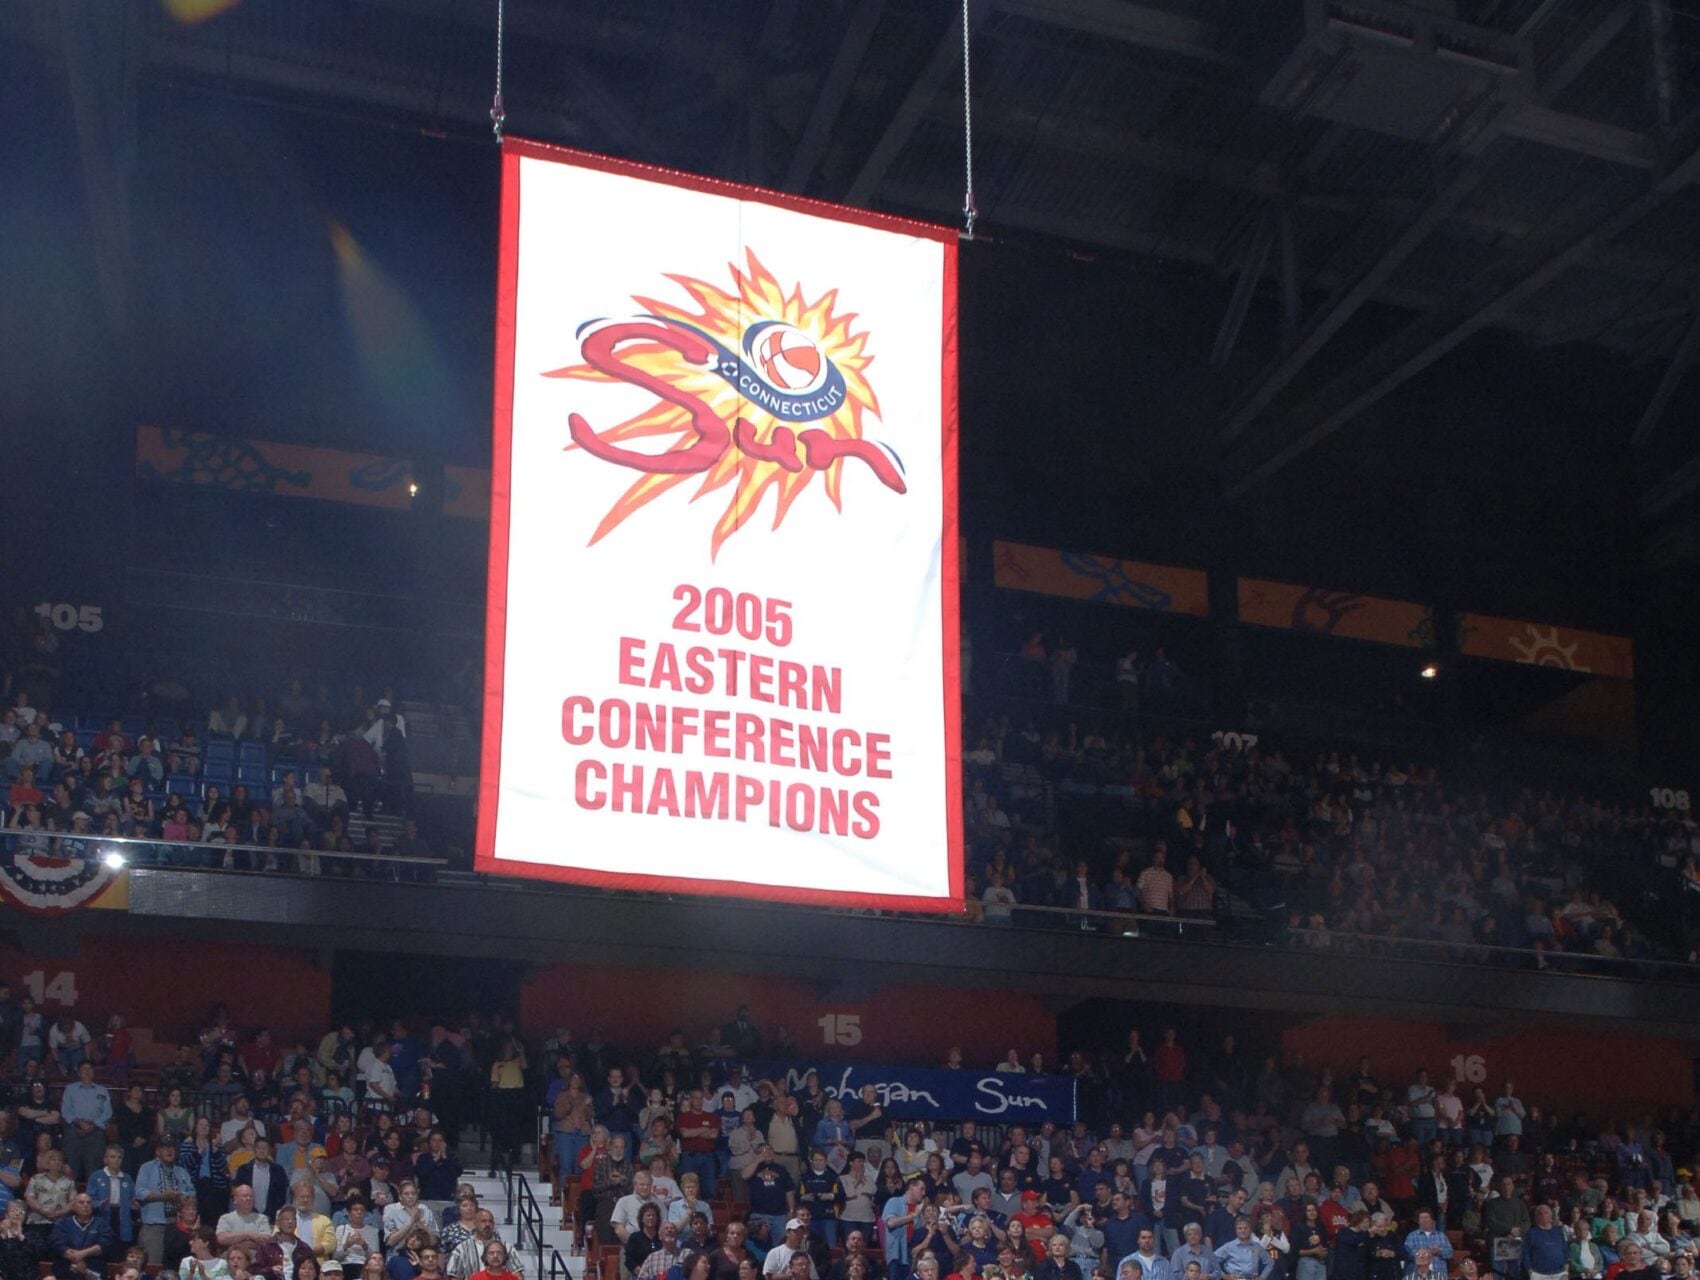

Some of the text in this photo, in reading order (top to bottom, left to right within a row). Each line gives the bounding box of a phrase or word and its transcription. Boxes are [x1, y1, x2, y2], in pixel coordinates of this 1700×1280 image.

[567, 322, 908, 495] Sun
[739, 375, 843, 416] CONNECTICUT
[672, 584, 793, 647] 2005
[619, 637, 842, 714] EASTERN
[561, 696, 893, 779] CONFERENCE
[574, 759, 881, 839] CHAMPIONS
[1649, 787, 1690, 810] 108
[23, 970, 79, 1006] 14
[818, 1013, 862, 1046] 15
[1450, 1054, 1487, 1083] 16
[975, 1077, 1047, 1114] Sun
